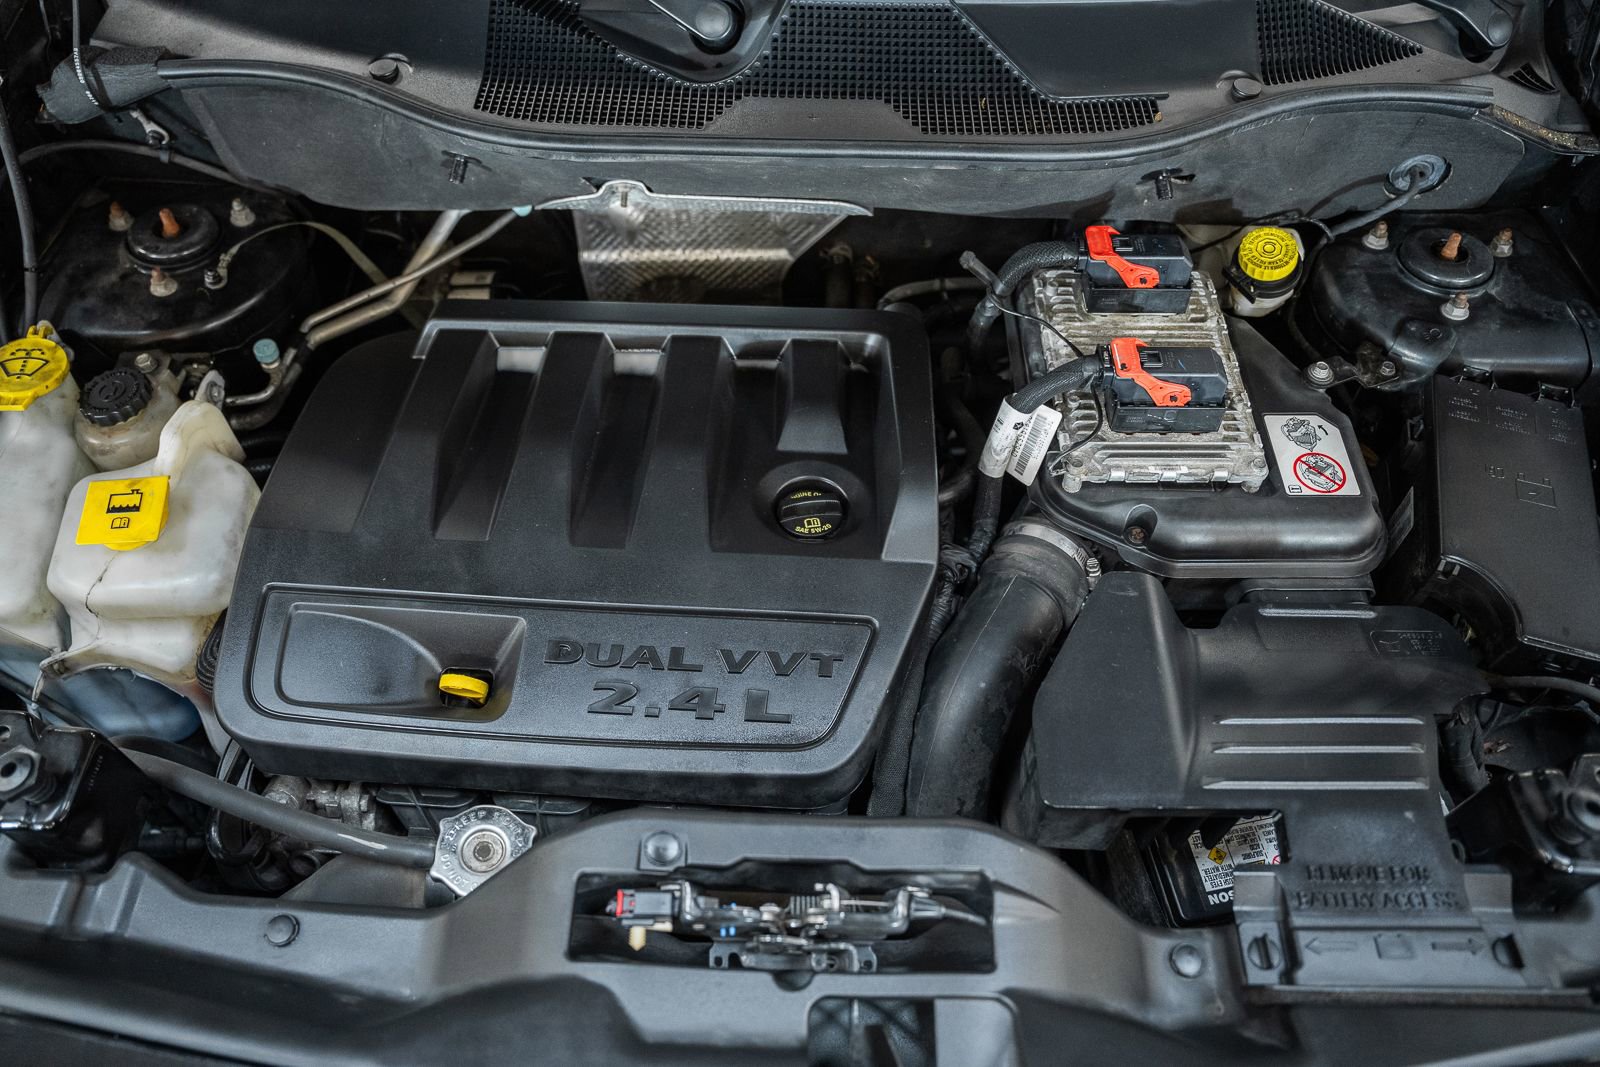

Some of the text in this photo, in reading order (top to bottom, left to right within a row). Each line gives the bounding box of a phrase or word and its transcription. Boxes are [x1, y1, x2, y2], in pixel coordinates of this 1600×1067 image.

[795, 526, 809, 534] SAE
[544, 639, 845, 678] DUAL VVT
[1306, 864, 1430, 883] REMOVE FOR
[1295, 890, 1459, 909] BATTERY ACCESS
